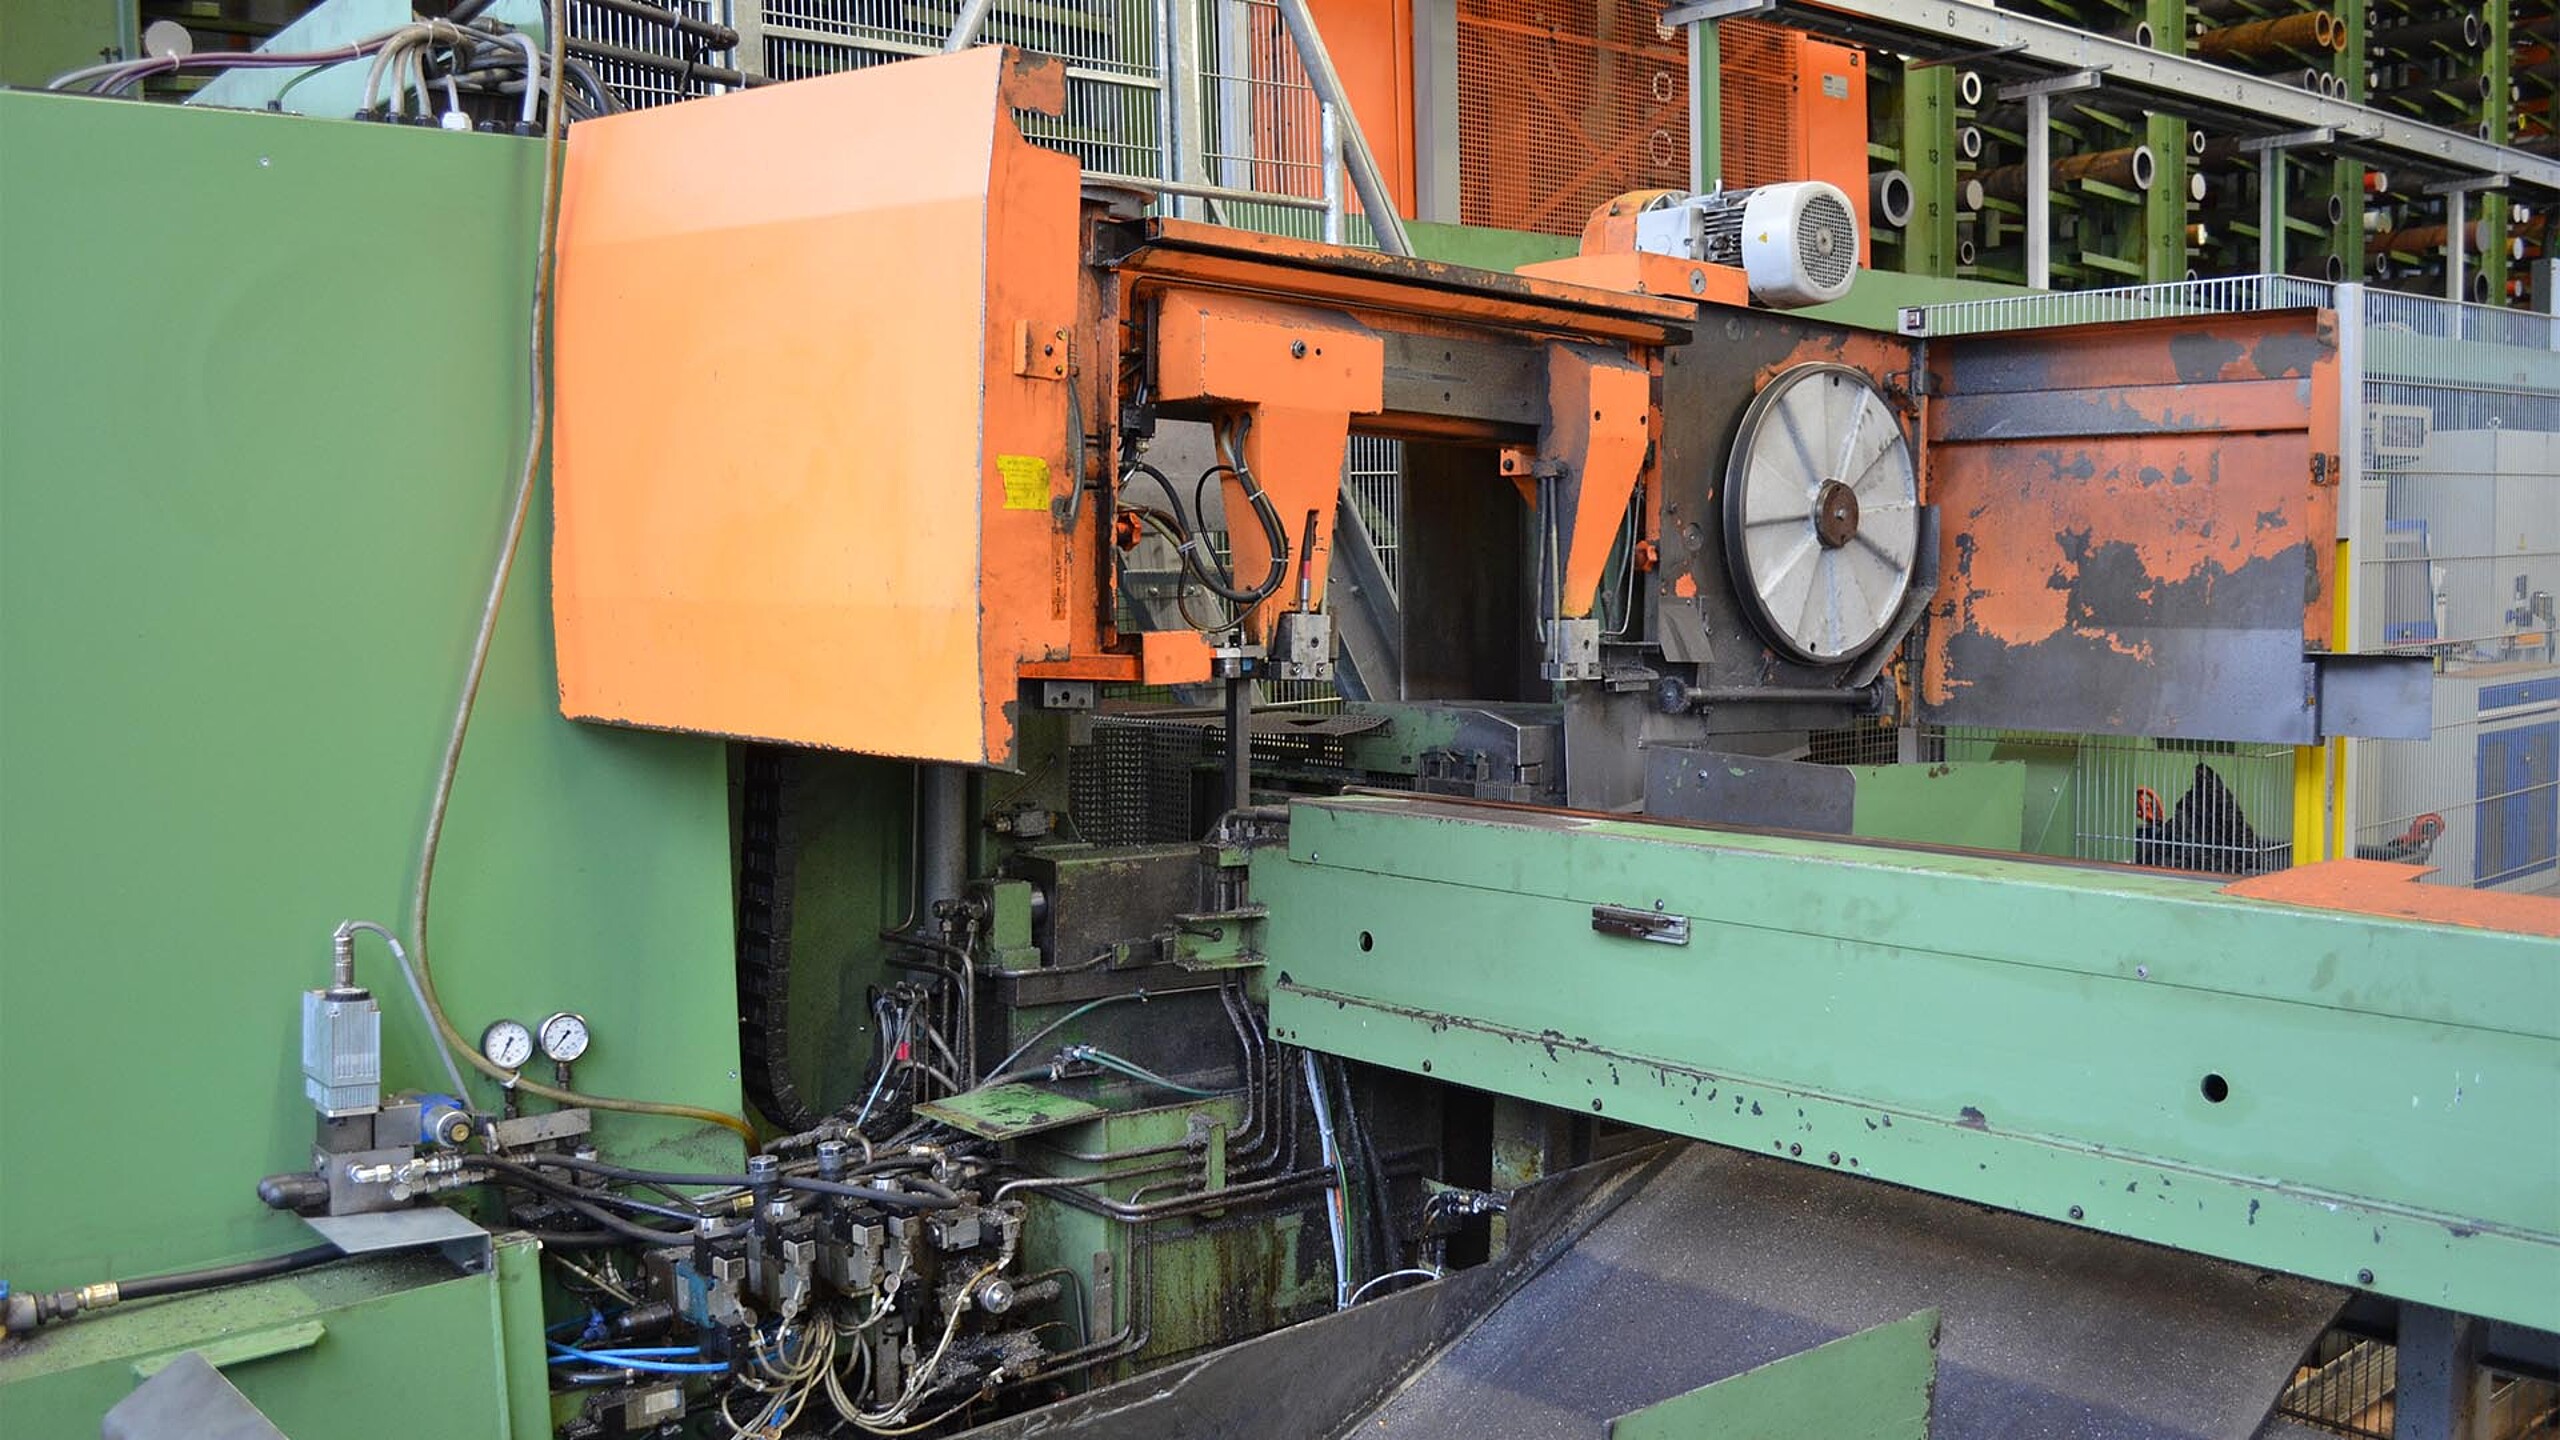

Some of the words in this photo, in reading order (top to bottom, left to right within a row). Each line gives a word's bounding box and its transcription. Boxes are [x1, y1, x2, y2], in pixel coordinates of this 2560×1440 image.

[1947, 10, 1956, 28] 6
[1928, 149, 1939, 164] 13
[1928, 202, 1938, 217] 12
[1928, 253, 1938, 268] 11
